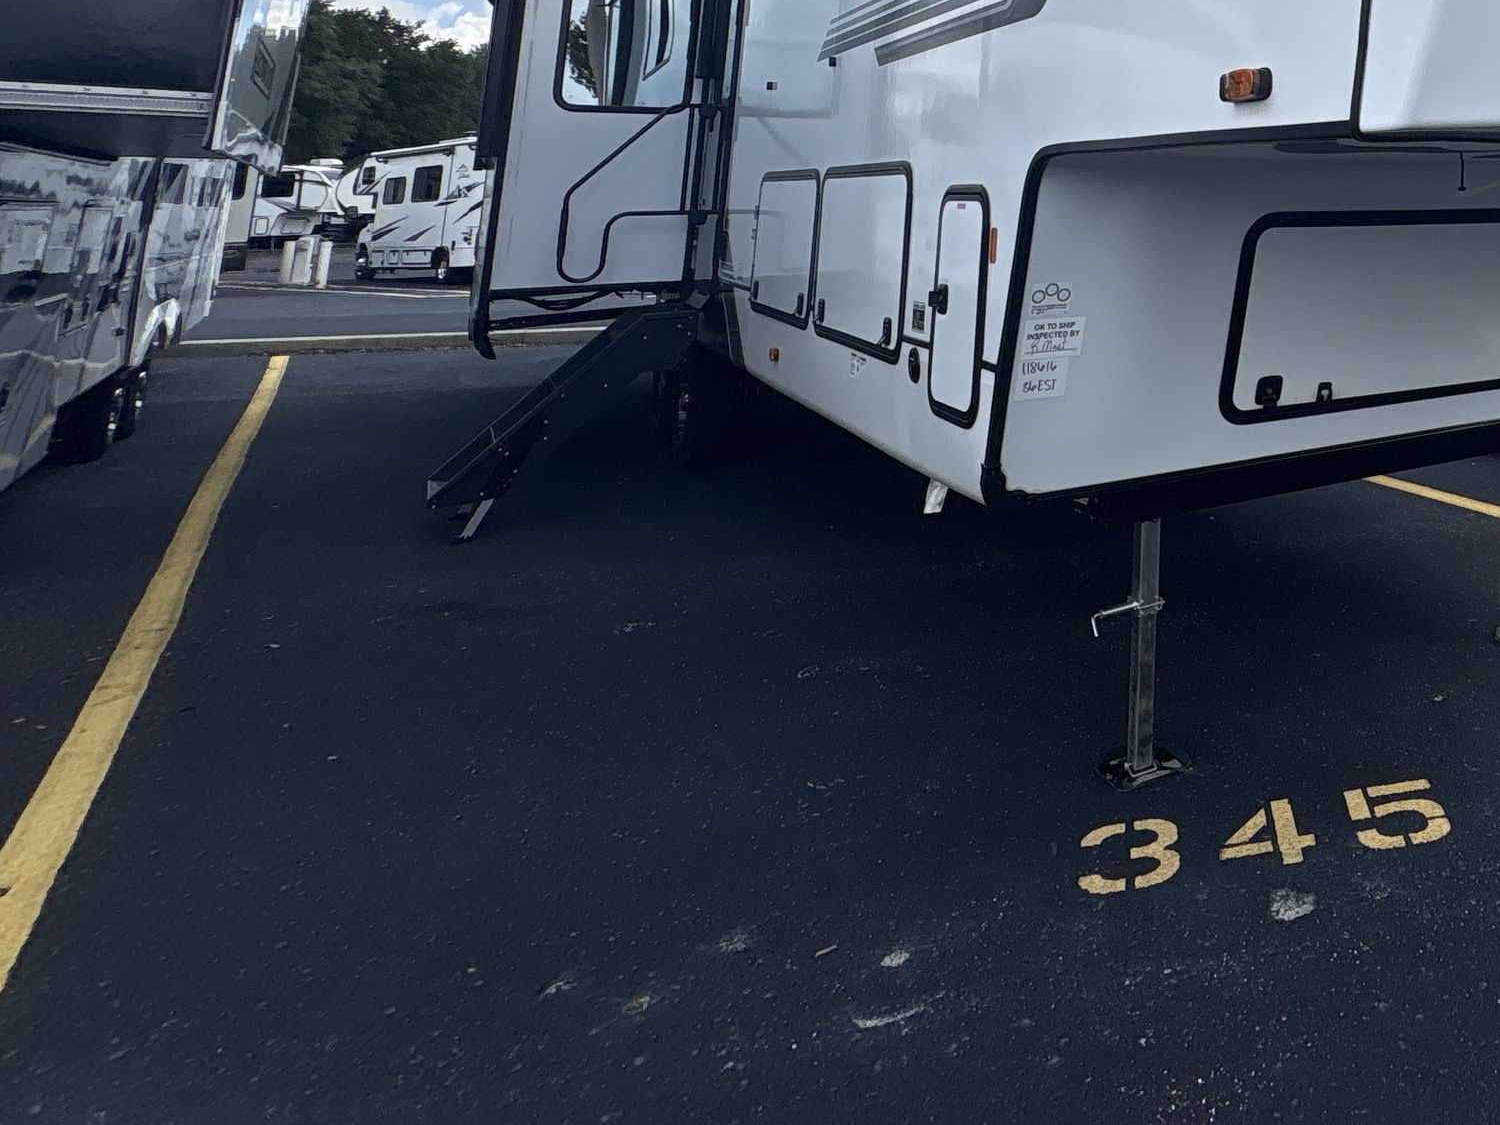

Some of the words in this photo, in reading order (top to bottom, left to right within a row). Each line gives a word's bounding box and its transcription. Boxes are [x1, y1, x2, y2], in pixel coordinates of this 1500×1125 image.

[1034, 323, 1046, 331] OK
[1047, 322, 1057, 331] TO
[1058, 321, 1076, 330] SHIP
[1027, 331, 1068, 341] INSPECTED
[1077, 778, 1452, 896] 345
